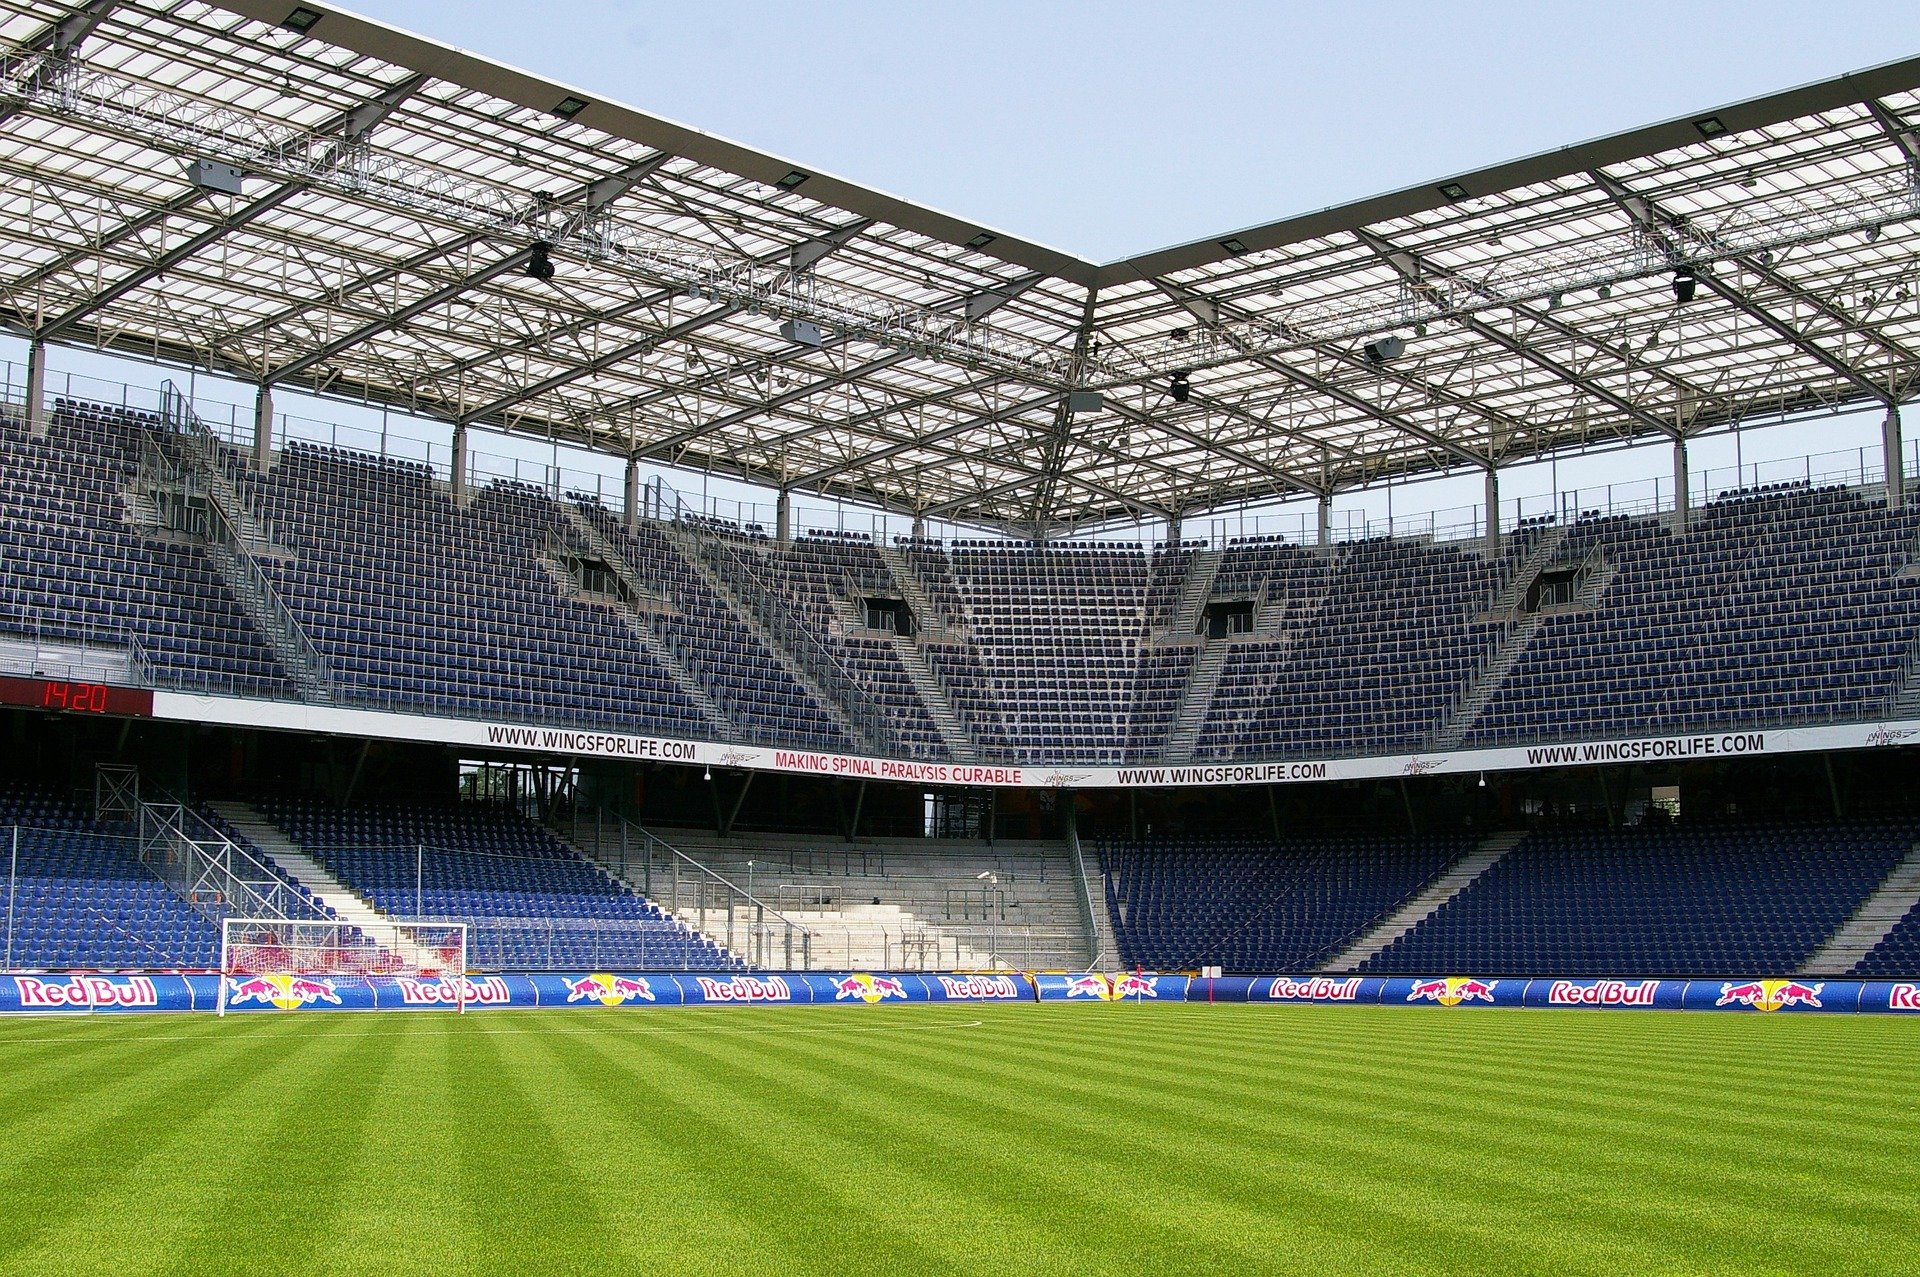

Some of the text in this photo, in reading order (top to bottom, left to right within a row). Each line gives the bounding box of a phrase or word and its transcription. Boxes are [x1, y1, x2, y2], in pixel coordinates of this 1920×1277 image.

[488, 726, 696, 760] WWW.WINGSFORLIFE.COM
[1527, 734, 1764, 765] WWW.WINGSFORLIFE.COM
[776, 752, 1022, 784] MAKING SPINAL PARALYSIS CURABLE
[1117, 763, 1326, 784] WWW.WINGSFORLIFE.COM
[19, 978, 156, 1004] Red Bull
[399, 978, 508, 1001] Red Bull
[700, 978, 789, 999] Red Bull
[941, 977, 1016, 996] Red Bull
[1271, 978, 1360, 998] Red Bull
[1550, 982, 1657, 1003] Red Bull
[1891, 985, 1920, 1008] Re
